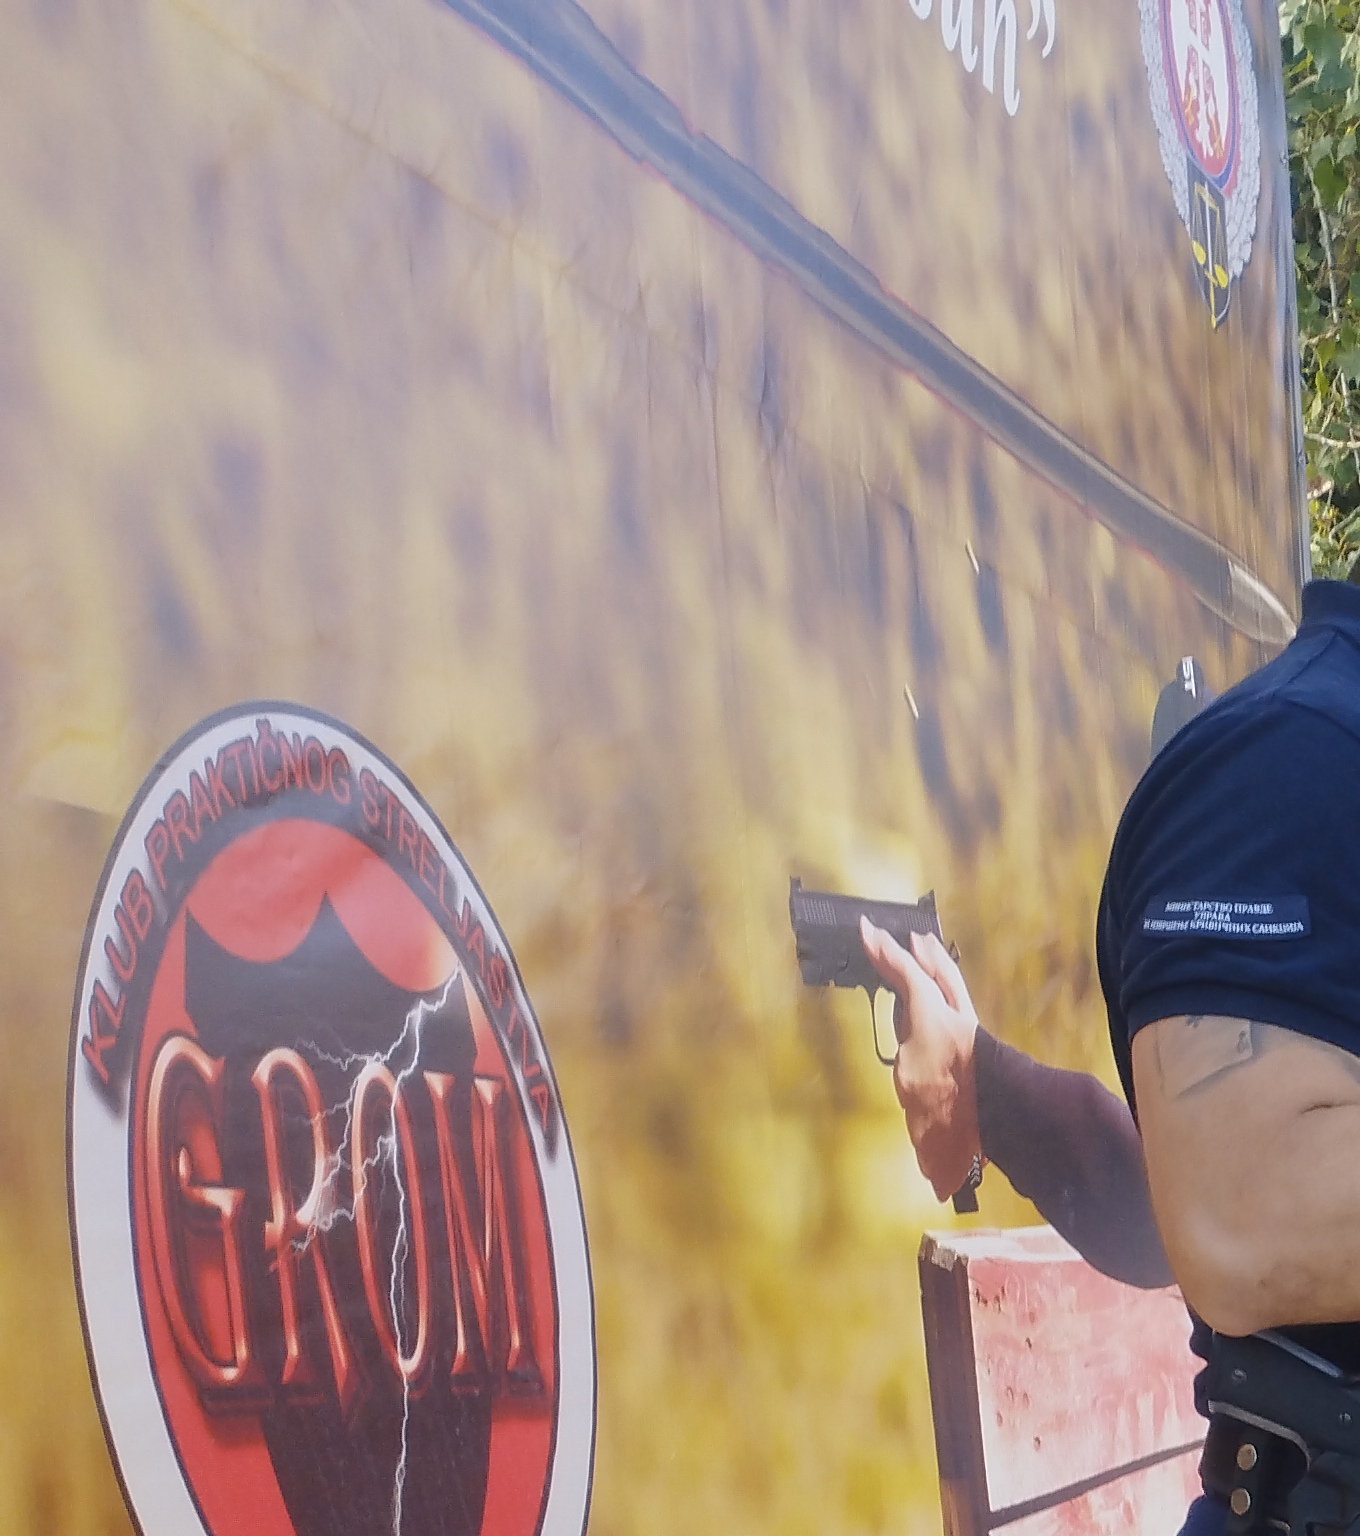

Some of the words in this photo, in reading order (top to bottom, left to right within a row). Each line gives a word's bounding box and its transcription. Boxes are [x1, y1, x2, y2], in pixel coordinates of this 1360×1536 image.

[82, 867, 153, 1082] KLUB
[144, 718, 352, 892] PRAKTIČNOG
[146, 1035, 540, 1405] GROM
